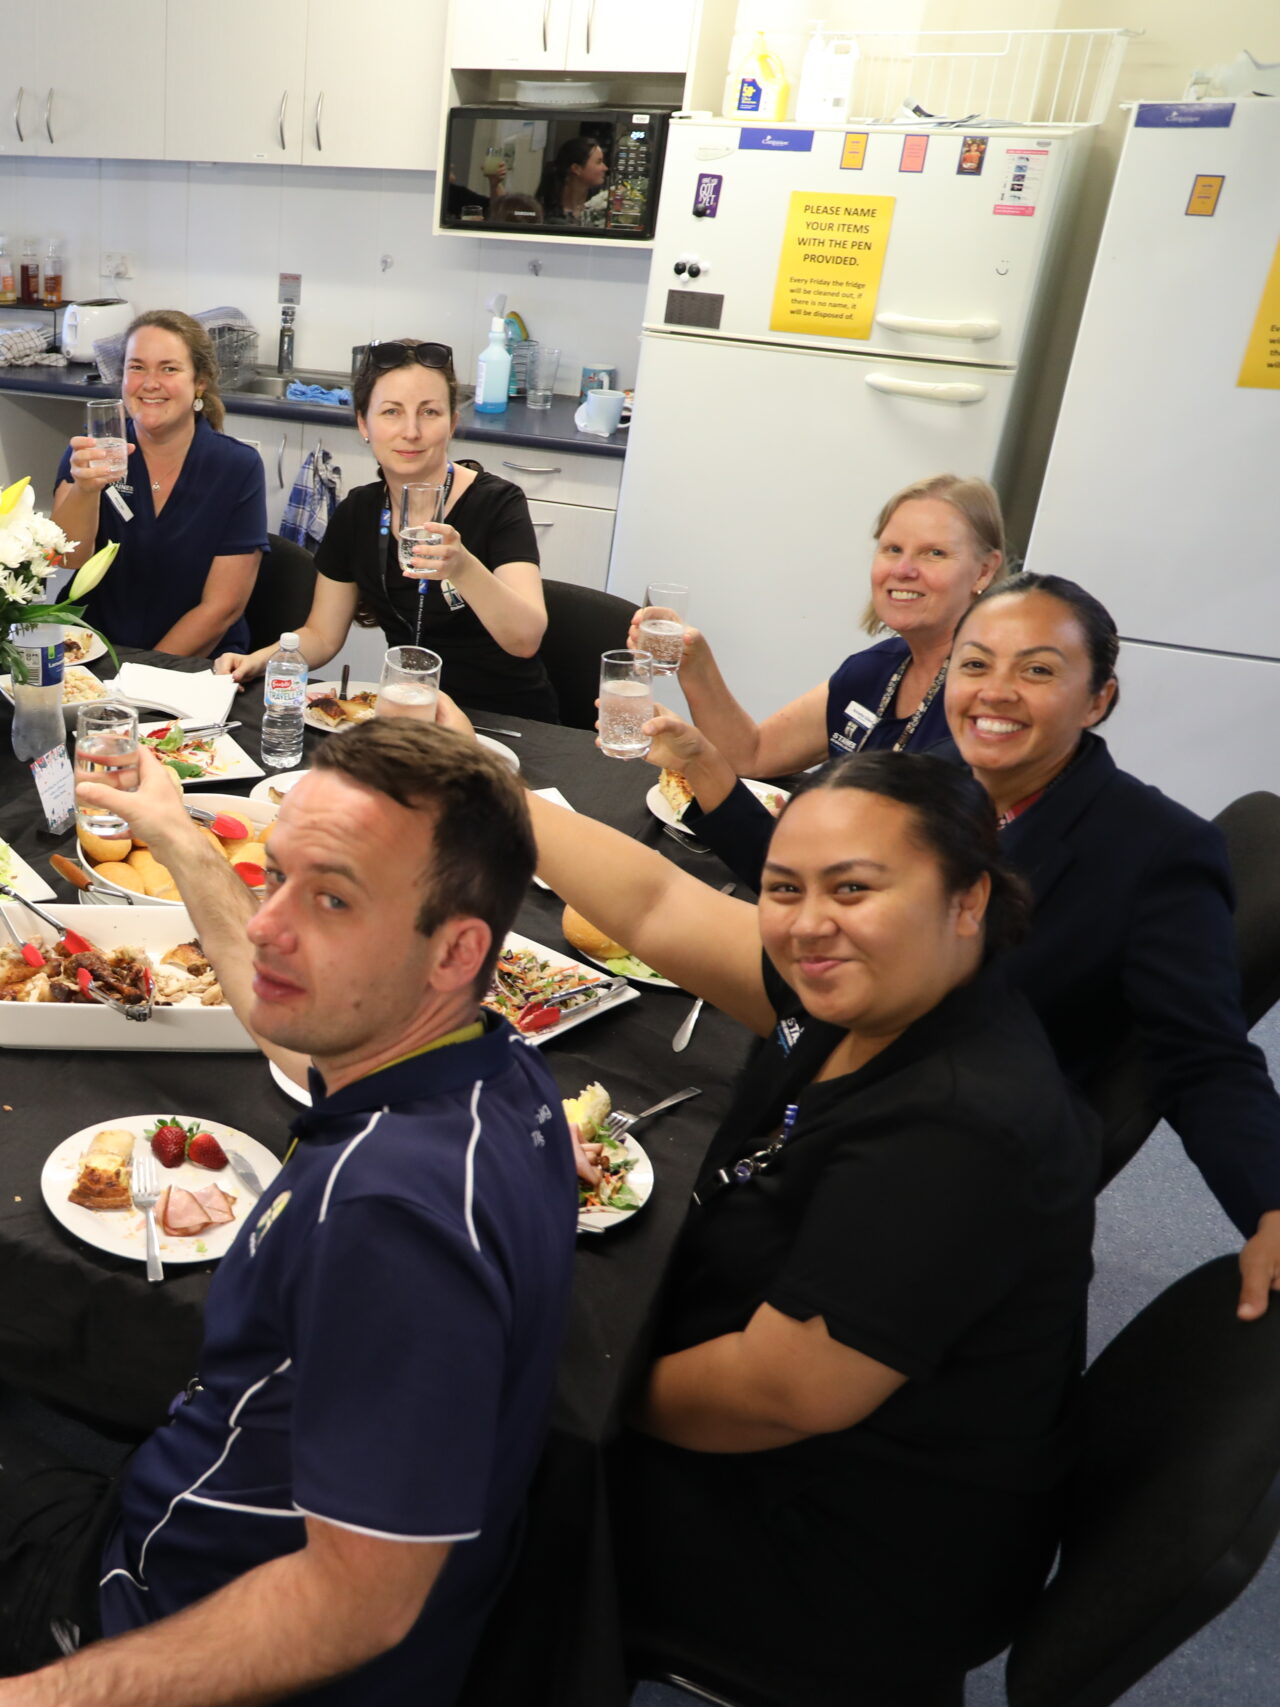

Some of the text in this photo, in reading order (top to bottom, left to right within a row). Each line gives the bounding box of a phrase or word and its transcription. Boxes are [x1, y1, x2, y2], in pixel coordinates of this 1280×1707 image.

[804, 204, 877, 218] PLEASE NAME
[806, 221, 870, 234] YOUR ITEMS
[798, 237, 872, 251] WITH THE PEN
[803, 254, 859, 266] PROVIDED.
[789, 277, 808, 285] Every
[809, 278, 831, 287] Friday
[845, 281, 866, 290] fridge
[813, 289, 840, 297] cleaned
[791, 298, 809, 306] there
[813, 311, 844, 319] disposed
